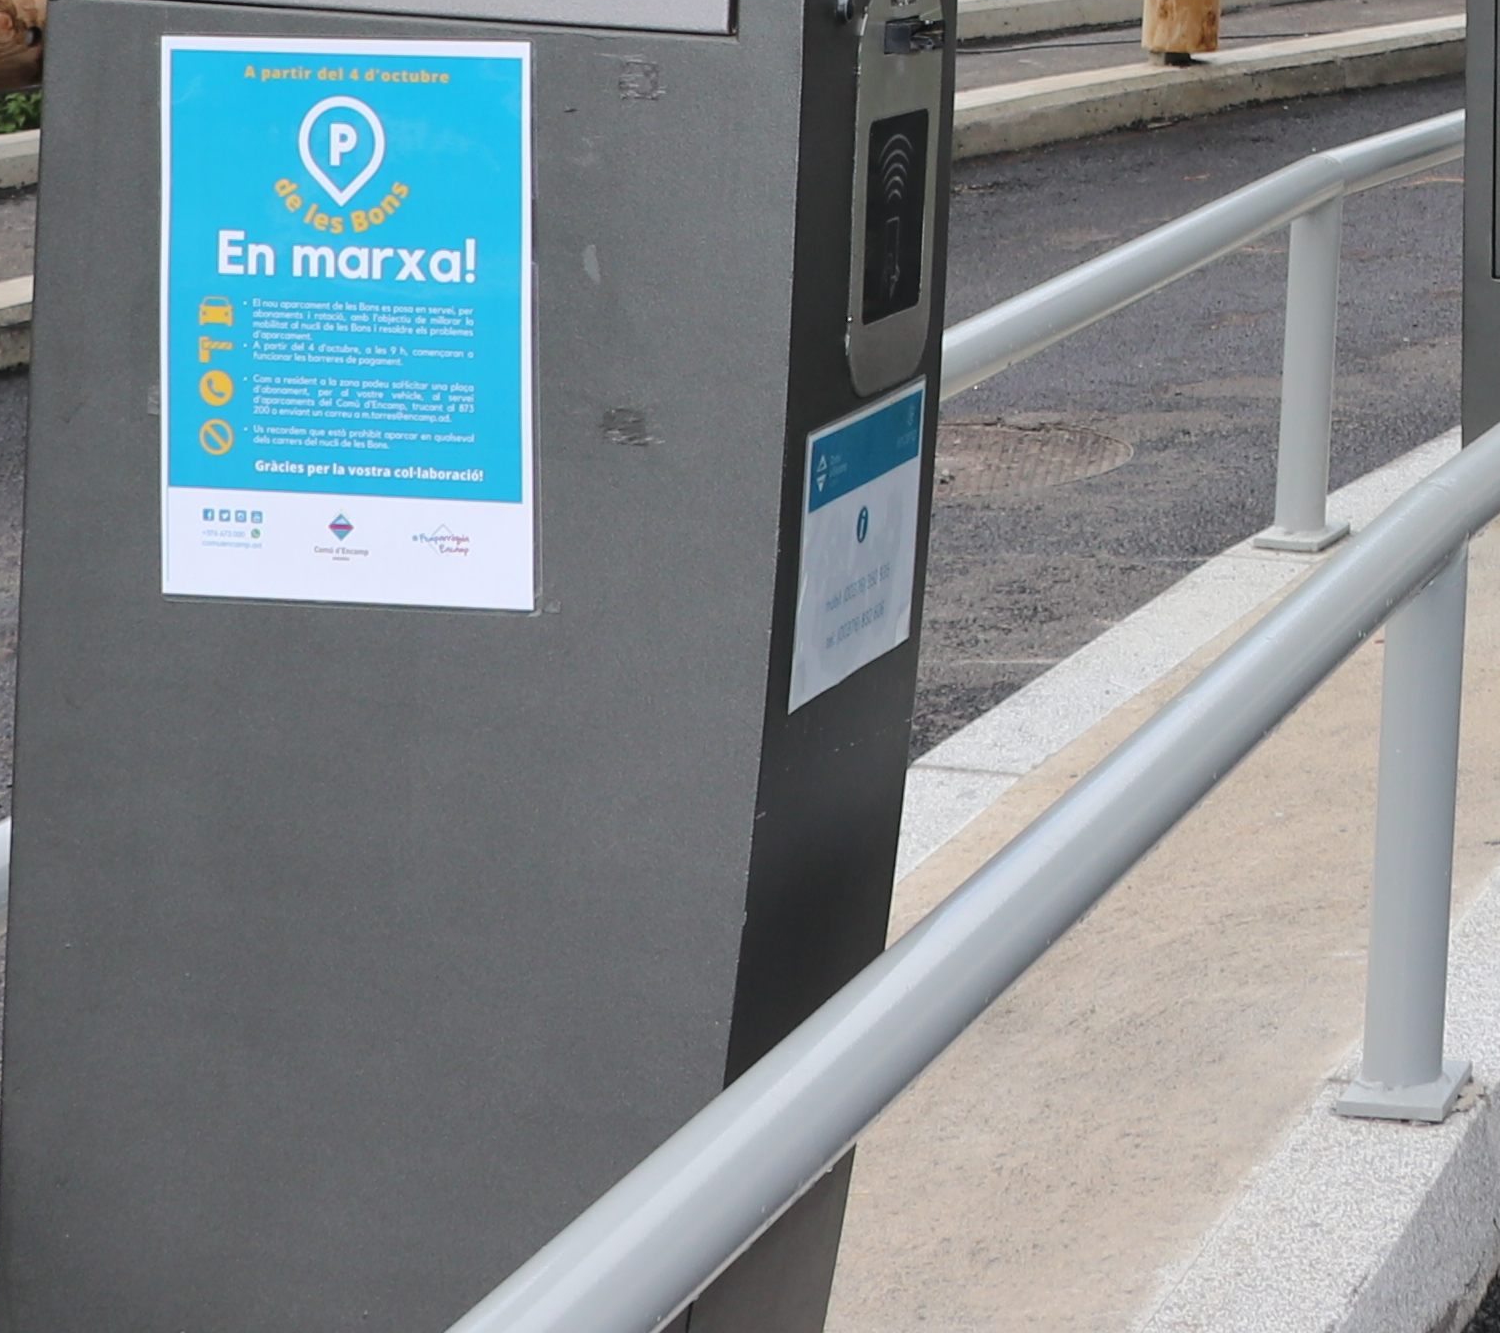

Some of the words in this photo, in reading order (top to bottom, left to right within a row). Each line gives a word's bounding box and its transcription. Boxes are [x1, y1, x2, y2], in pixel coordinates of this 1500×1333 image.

[244, 66, 255, 77] A
[261, 67, 311, 81] partir
[317, 67, 344, 80] del
[350, 69, 359, 80] 4
[365, 69, 450, 83] d'octubre
[330, 123, 358, 166] P
[274, 178, 303, 212] de
[304, 203, 344, 234] les
[351, 182, 410, 232] Bons
[218, 229, 275, 275] En
[292, 238, 477, 283] marxa!
[253, 298, 261, 307] El
[332, 301, 343, 310] de
[345, 303, 357, 311] les
[458, 308, 474, 316] per
[337, 323, 348, 331] les
[415, 316, 426, 324] de
[466, 317, 474, 326] la
[253, 341, 261, 349] A
[264, 342, 287, 350] partir
[291, 343, 305, 351] del
[375, 346, 386, 354] les
[294, 353, 306, 361] les
[346, 356, 357, 364] de
[253, 374, 272, 383] Com
[328, 378, 337, 386] la
[319, 398, 333, 406] del
[447, 404, 455, 412] al
[253, 436, 270, 444] dels
[305, 438, 317, 446] del
[341, 439, 351, 447] de
[255, 460, 304, 473] Gràcies
[307, 465, 330, 477] per
[333, 463, 345, 475] la
[348, 467, 391, 477] vostra
